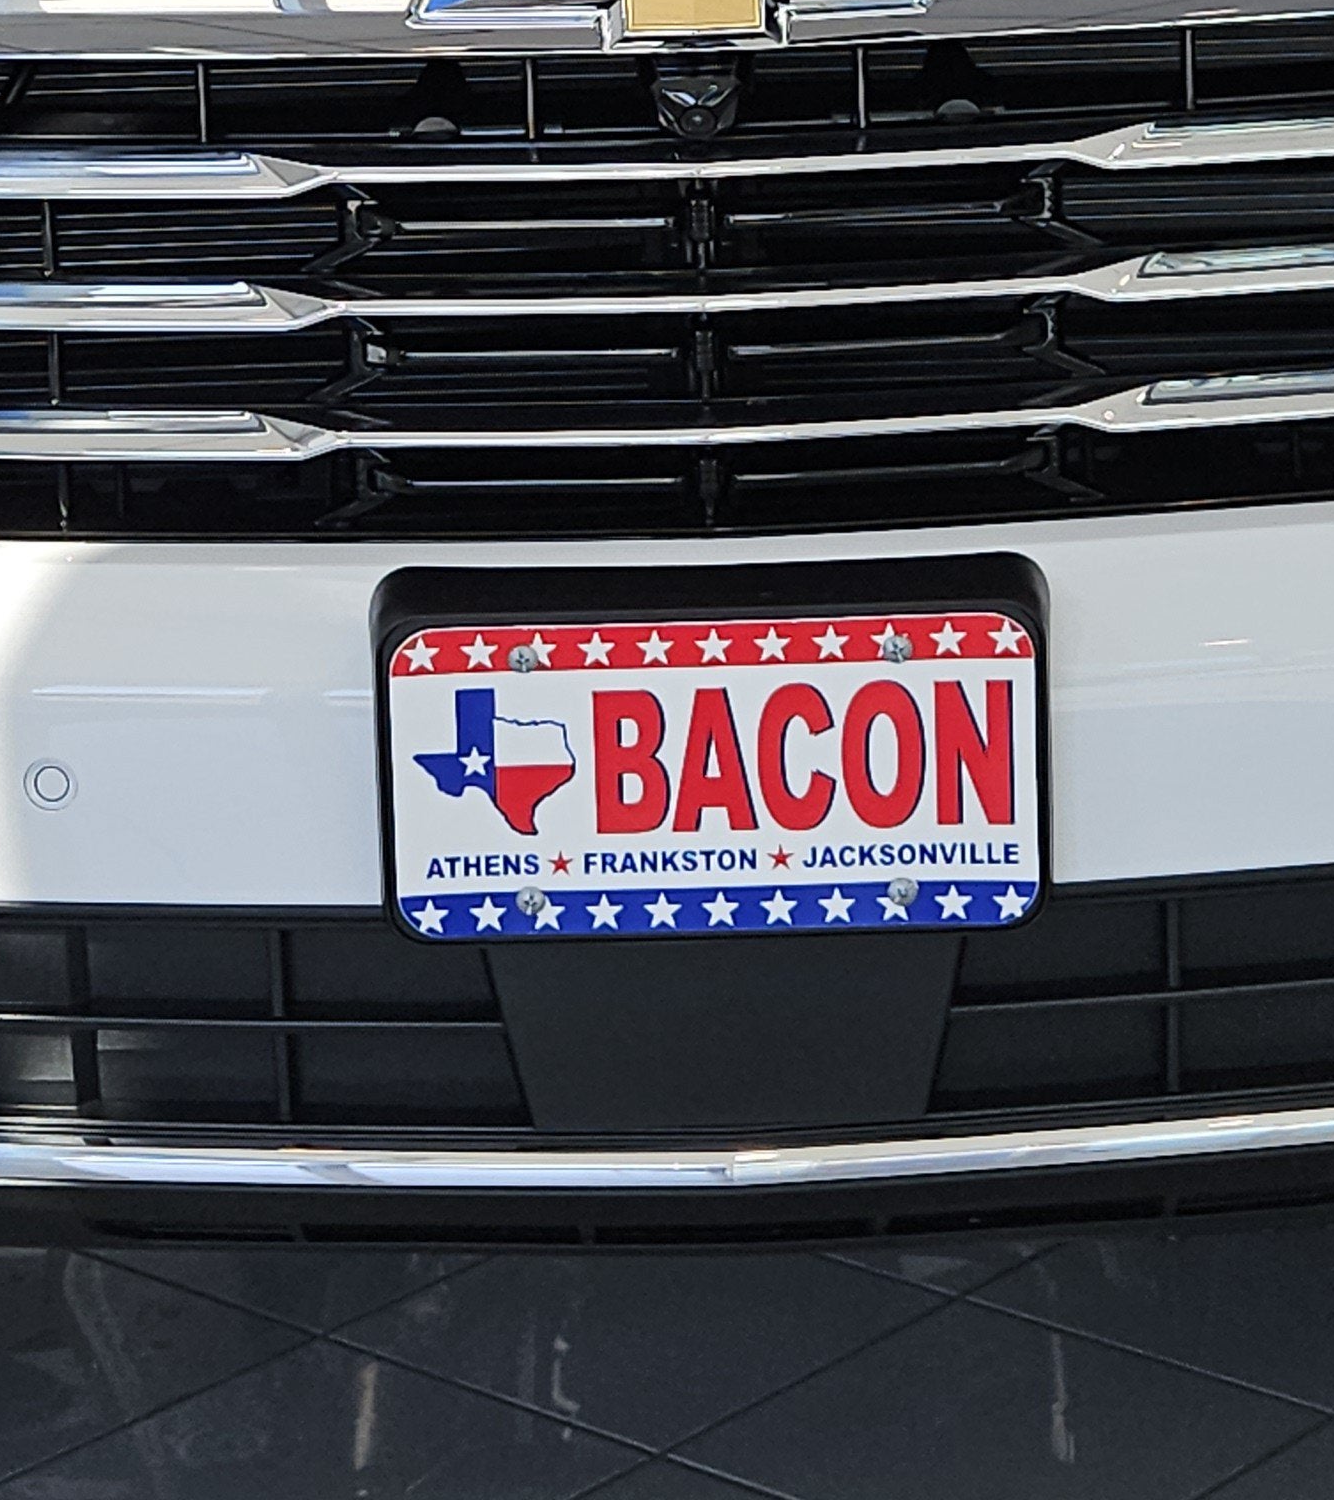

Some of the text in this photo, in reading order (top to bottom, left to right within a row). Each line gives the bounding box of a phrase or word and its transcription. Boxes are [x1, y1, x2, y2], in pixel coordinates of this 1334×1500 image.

[592, 679, 1016, 835] BACON
[425, 842, 1021, 880] ATHENS FRANKSTON JACKSONVILLE
